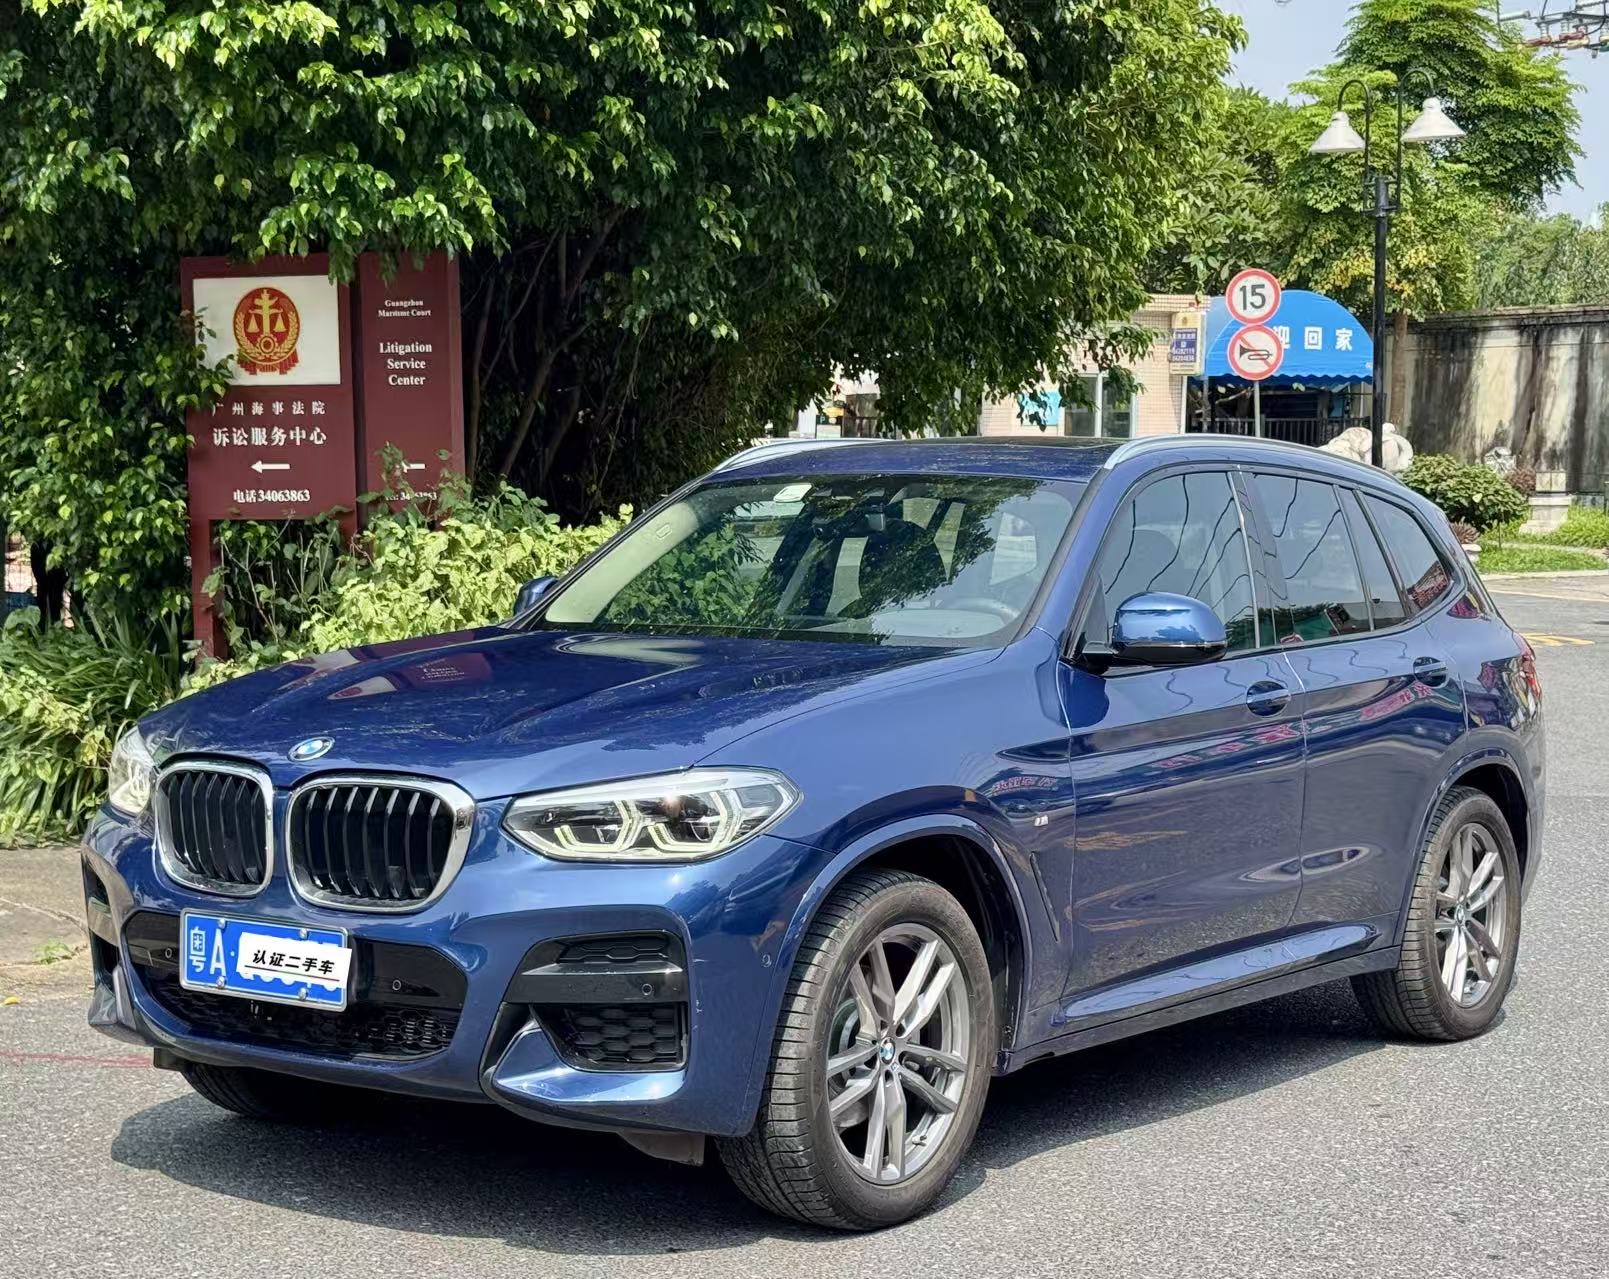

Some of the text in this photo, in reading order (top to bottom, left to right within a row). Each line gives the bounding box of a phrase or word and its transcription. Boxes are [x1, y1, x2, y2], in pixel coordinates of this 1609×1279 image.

[1240, 284, 1266, 310] 15
[411, 308, 432, 317] Court
[379, 341, 433, 355] Litigation
[386, 358, 426, 369] Service
[388, 374, 426, 386] Center
[212, 426, 328, 447] 诉讼服务中心
